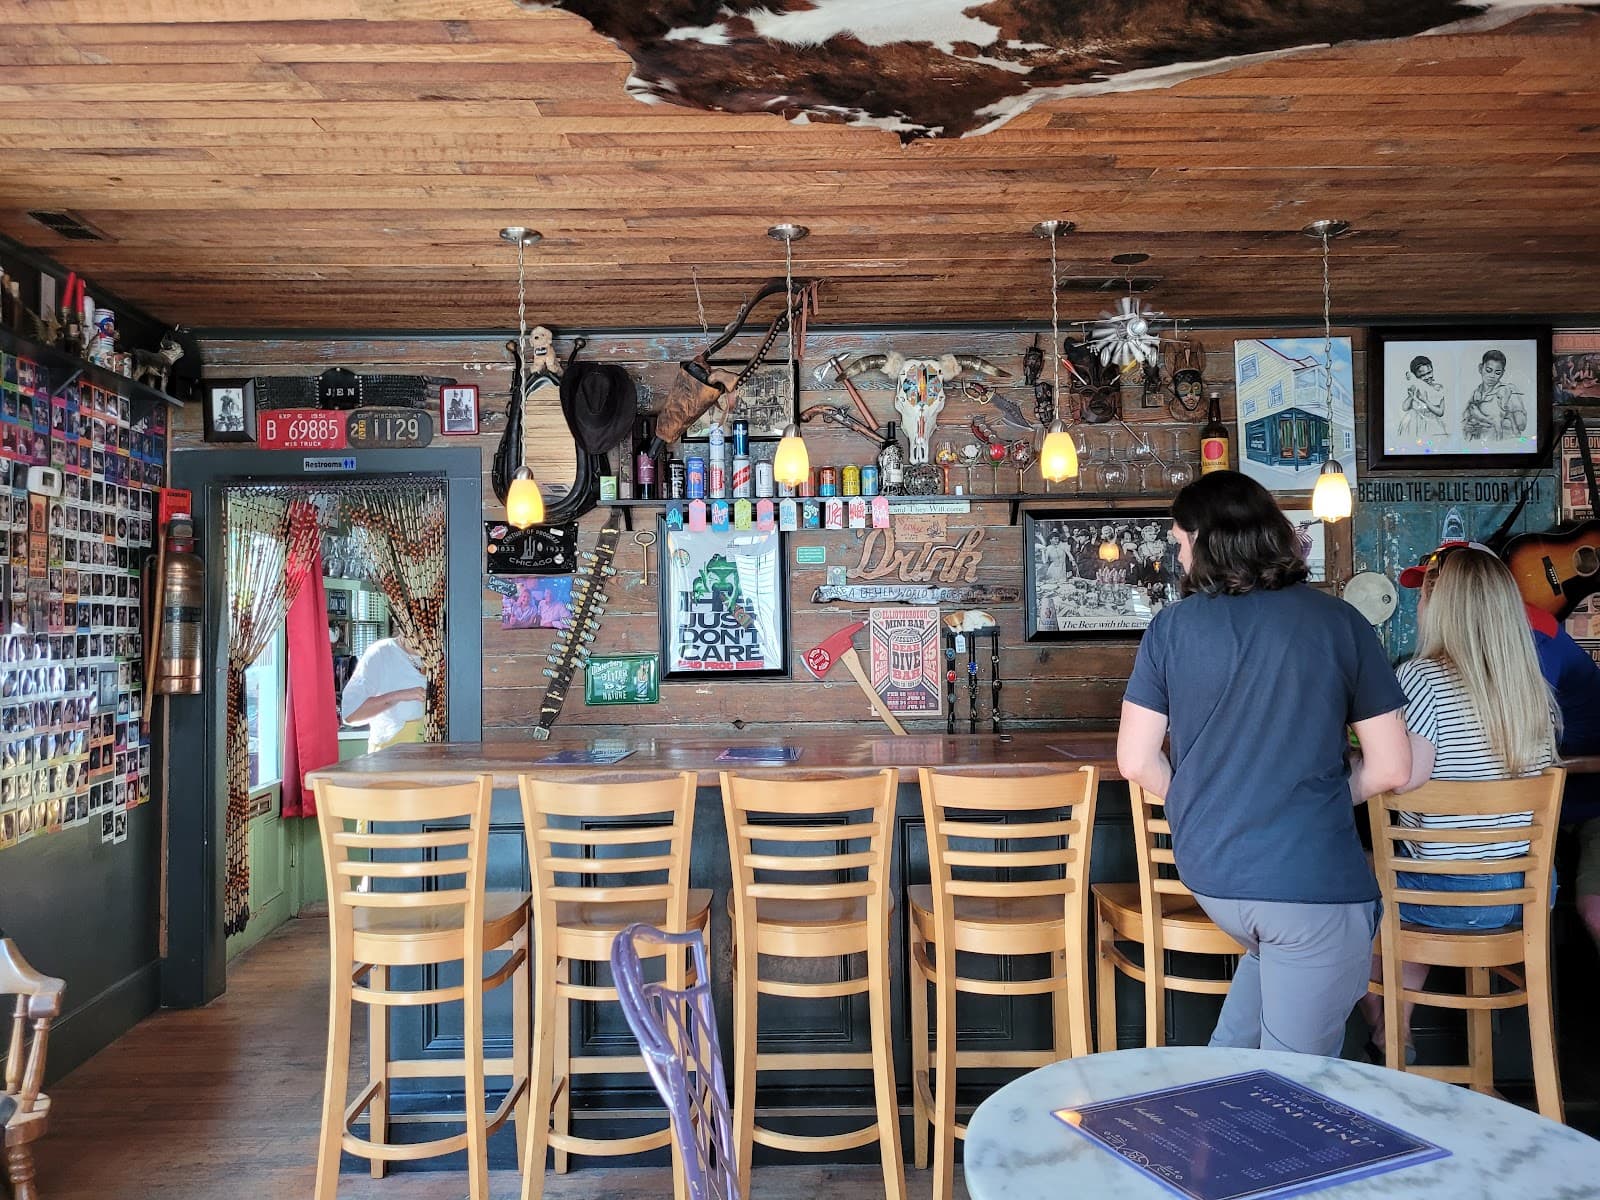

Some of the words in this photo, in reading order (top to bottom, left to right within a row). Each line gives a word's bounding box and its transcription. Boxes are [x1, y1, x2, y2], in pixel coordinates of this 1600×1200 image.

[266, 419, 277, 441] B
[288, 419, 339, 441] 69885
[374, 418, 419, 441] 1129
[305, 460, 343, 469] Restrooms
[1357, 482, 1404, 503] BEHIND
[1406, 482, 1432, 502] THE
[1438, 482, 1470, 501] BLUE
[1474, 481, 1509, 501] DOOR
[508, 557, 553, 567] CHICAGO
[847, 526, 986, 583] Drink
[885, 619, 906, 630] MINI
[907, 619, 926, 630] BAR
[1063, 620, 1078, 629] The
[1079, 620, 1097, 629] Beer
[1099, 620, 1116, 629] with
[1117, 619, 1129, 629] the
[678, 628, 759, 645] DON'T
[679, 644, 764, 662] CARE
[892, 651, 921, 671] DIVE
[892, 669, 921, 680] BAR
